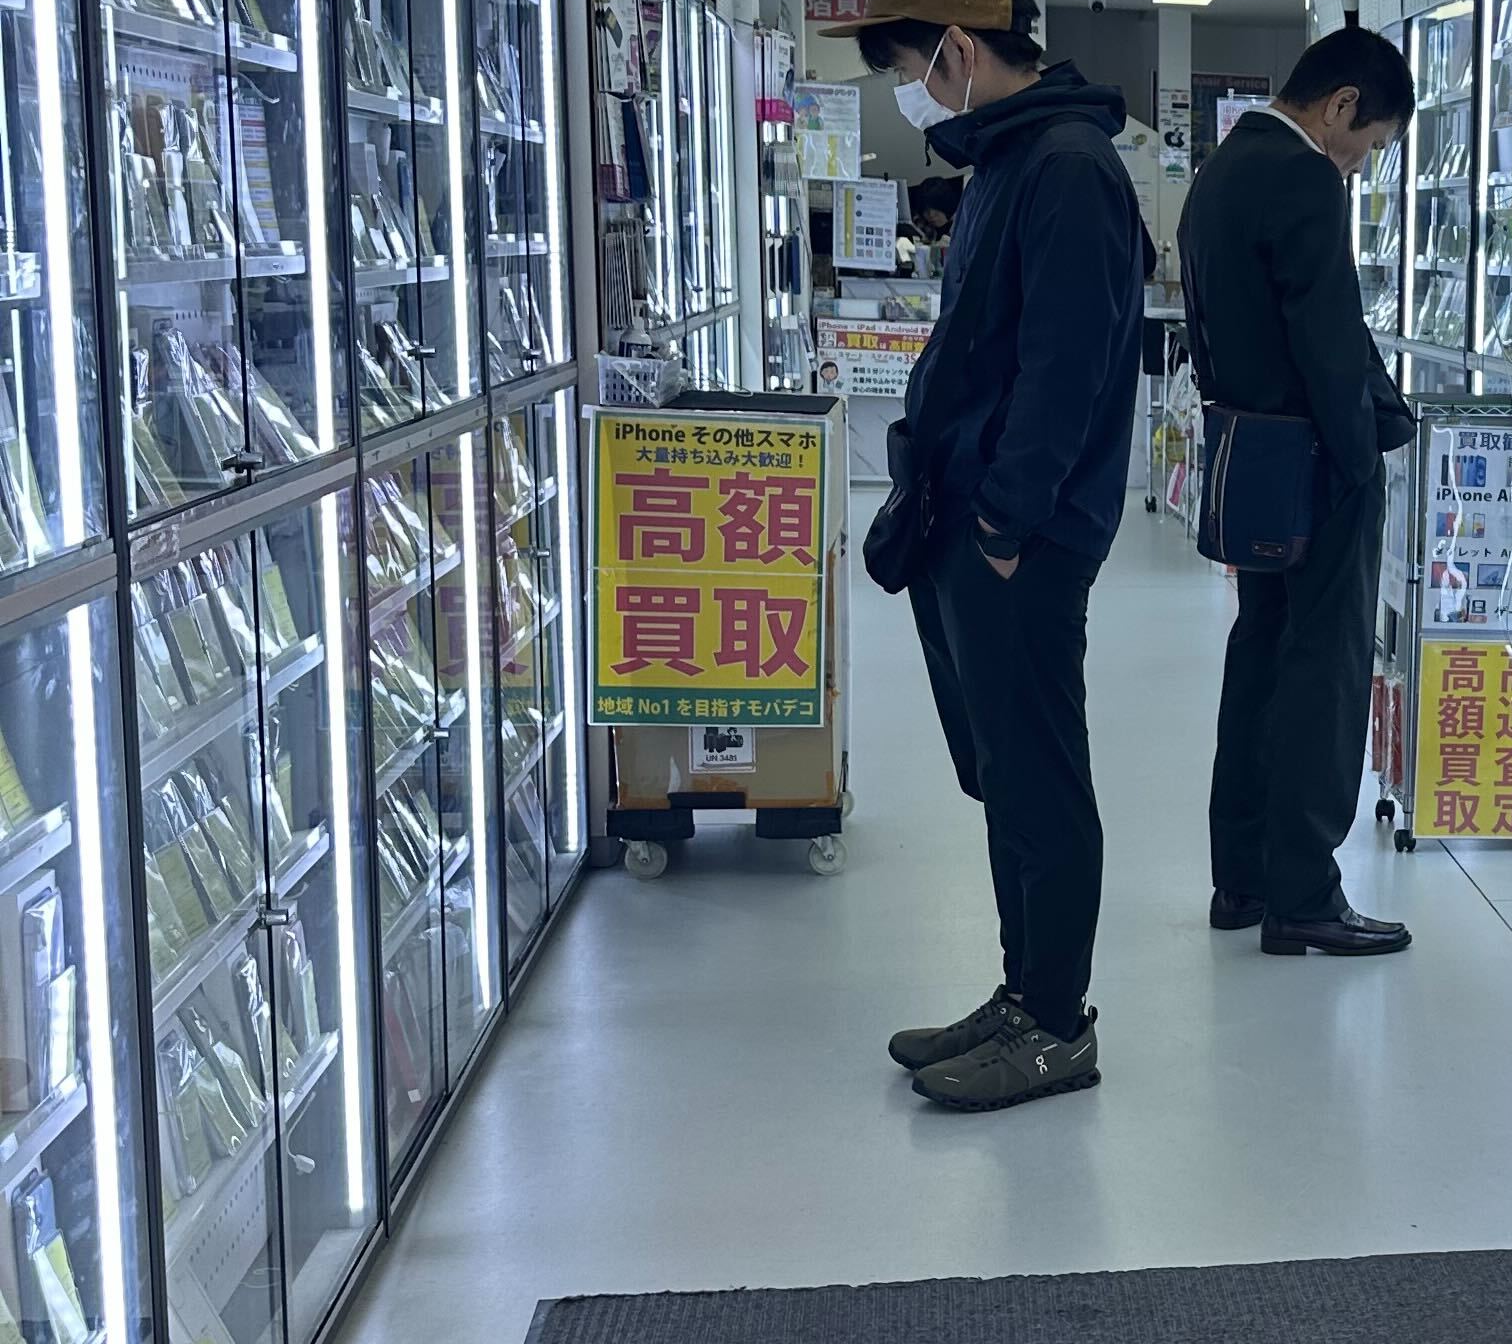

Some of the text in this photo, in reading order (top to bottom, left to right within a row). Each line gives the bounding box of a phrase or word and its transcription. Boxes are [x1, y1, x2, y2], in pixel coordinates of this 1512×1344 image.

[615, 423, 816, 449] iPhone その他スマホ
[636, 446, 804, 468] 大量持ち込み大歓迎！
[615, 467, 817, 566] 高額
[609, 586, 811, 678] 買取
[1433, 646, 1488, 834] 高額買取
